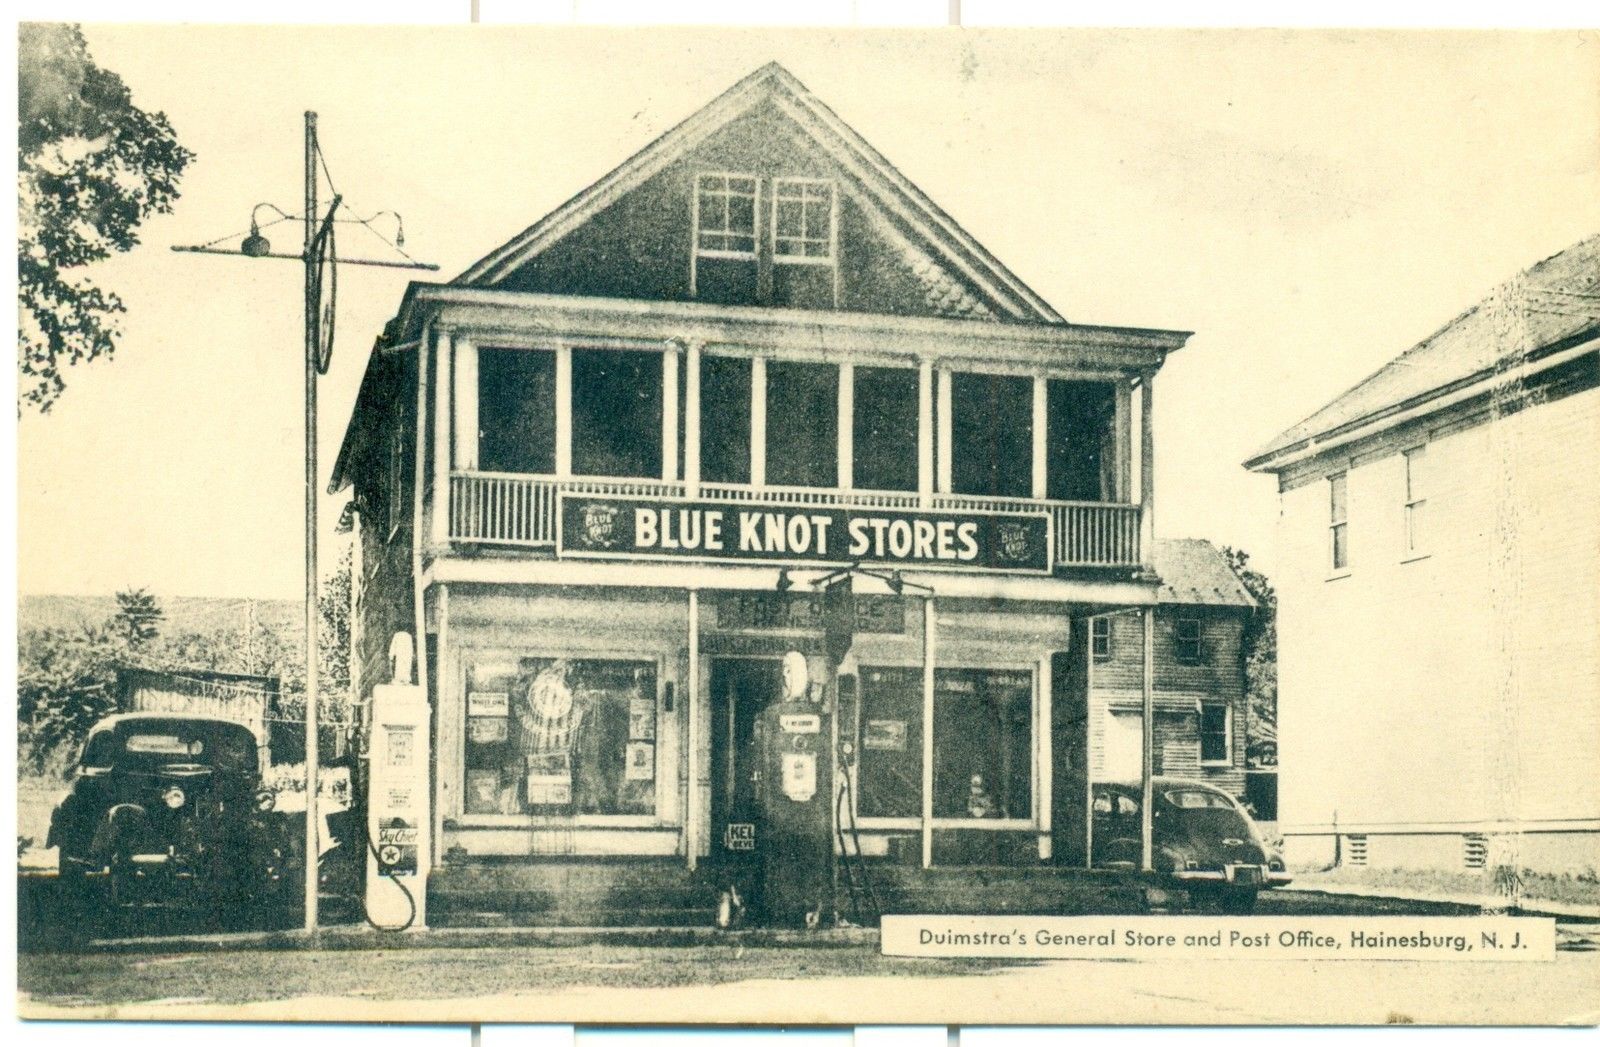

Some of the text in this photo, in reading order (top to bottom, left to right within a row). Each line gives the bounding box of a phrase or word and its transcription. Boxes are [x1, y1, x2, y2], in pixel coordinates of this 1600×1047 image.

[634, 507, 979, 562] BLUE KNOT STORES
